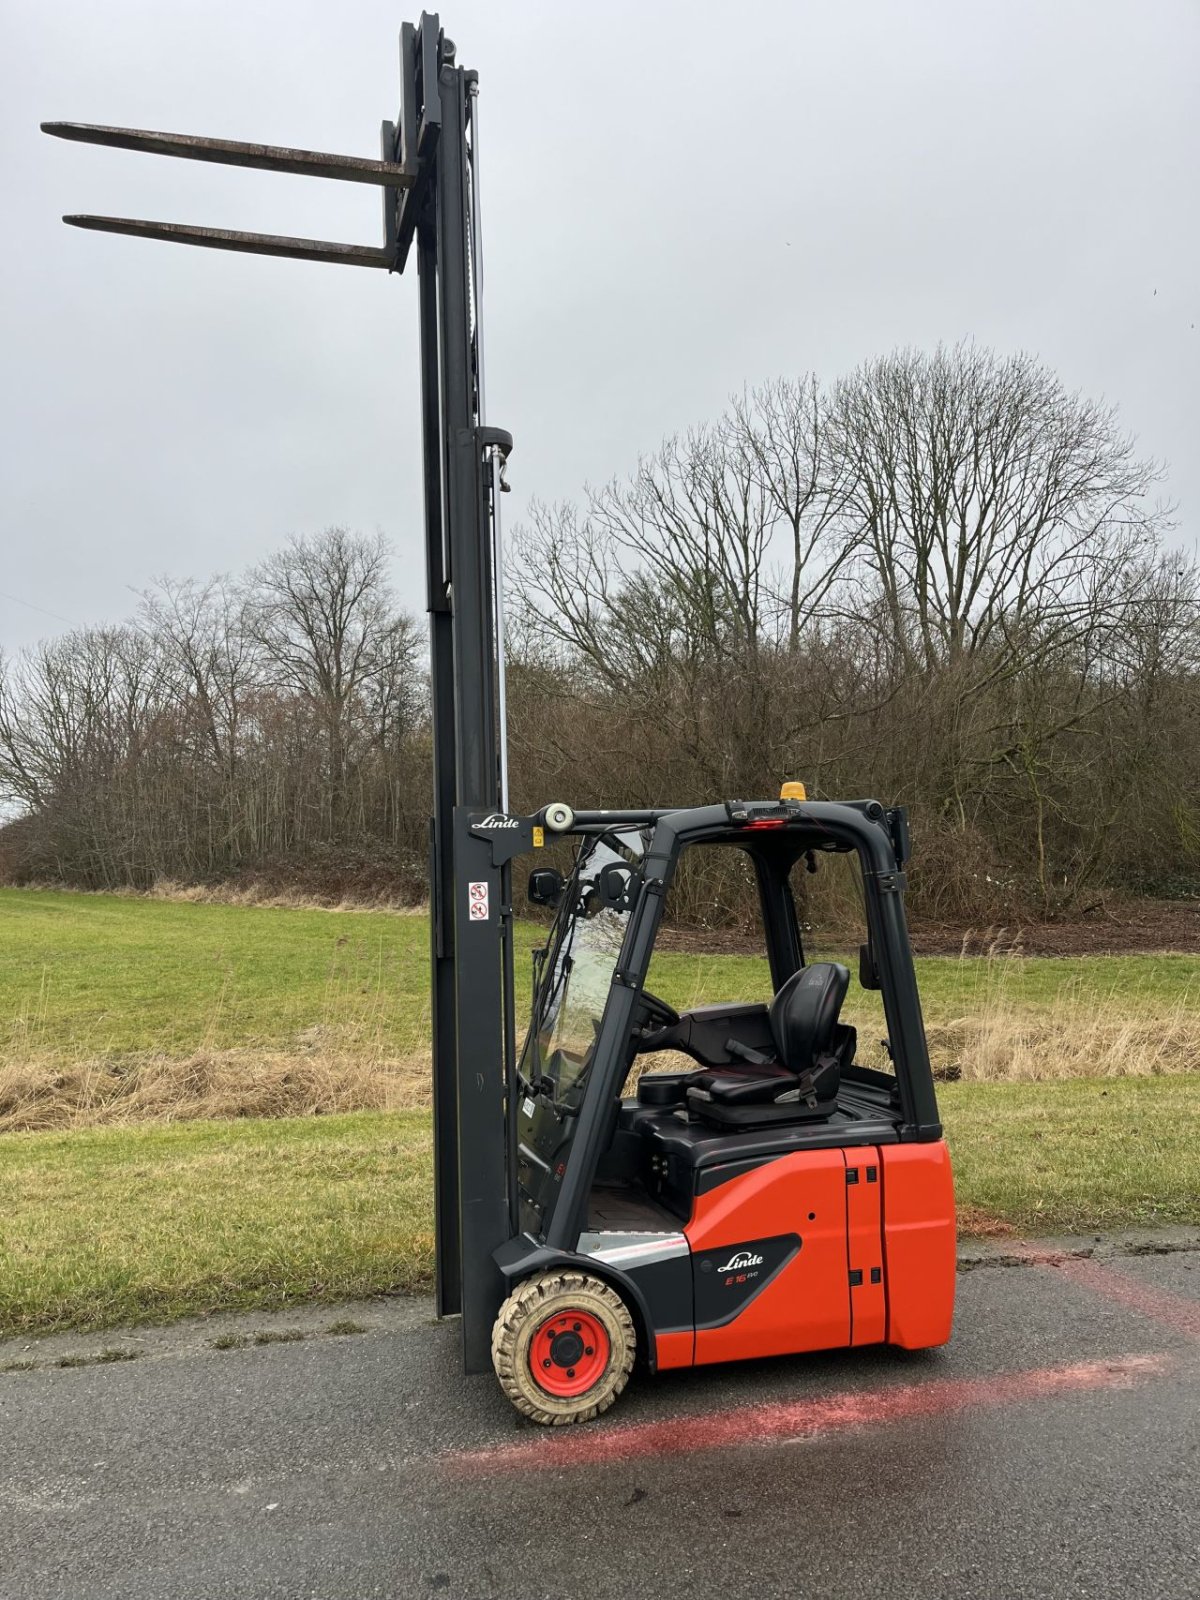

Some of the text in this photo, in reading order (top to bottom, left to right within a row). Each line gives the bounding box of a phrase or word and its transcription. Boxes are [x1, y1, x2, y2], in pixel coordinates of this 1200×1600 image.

[472, 813, 519, 829] Linde
[717, 1251, 763, 1272] Linde
[725, 1276, 734, 1286] E
